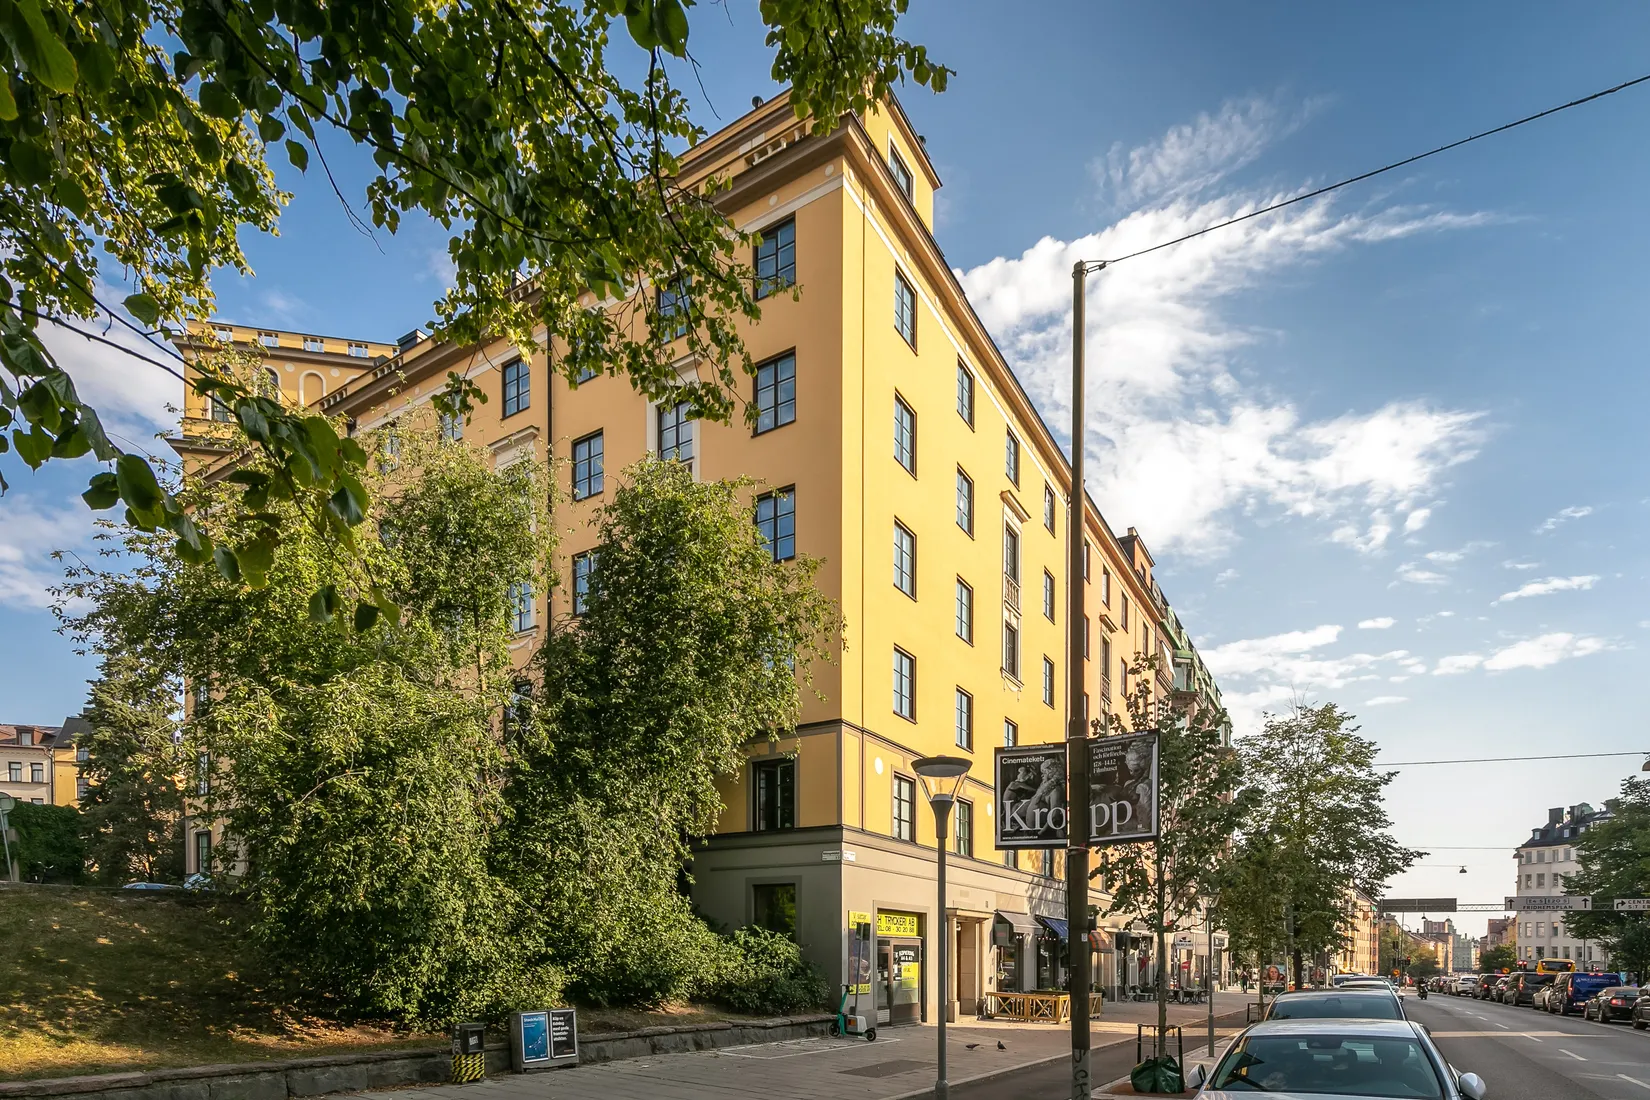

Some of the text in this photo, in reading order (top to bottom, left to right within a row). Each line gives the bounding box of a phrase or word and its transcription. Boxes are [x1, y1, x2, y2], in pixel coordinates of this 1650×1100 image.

[1093, 746, 1122, 754] Fascination
[1094, 766, 1118, 774] Filmhuset
[1002, 799, 1066, 832] Kro
[1090, 800, 1132, 838] pp
[908, 917, 915, 927] AB
